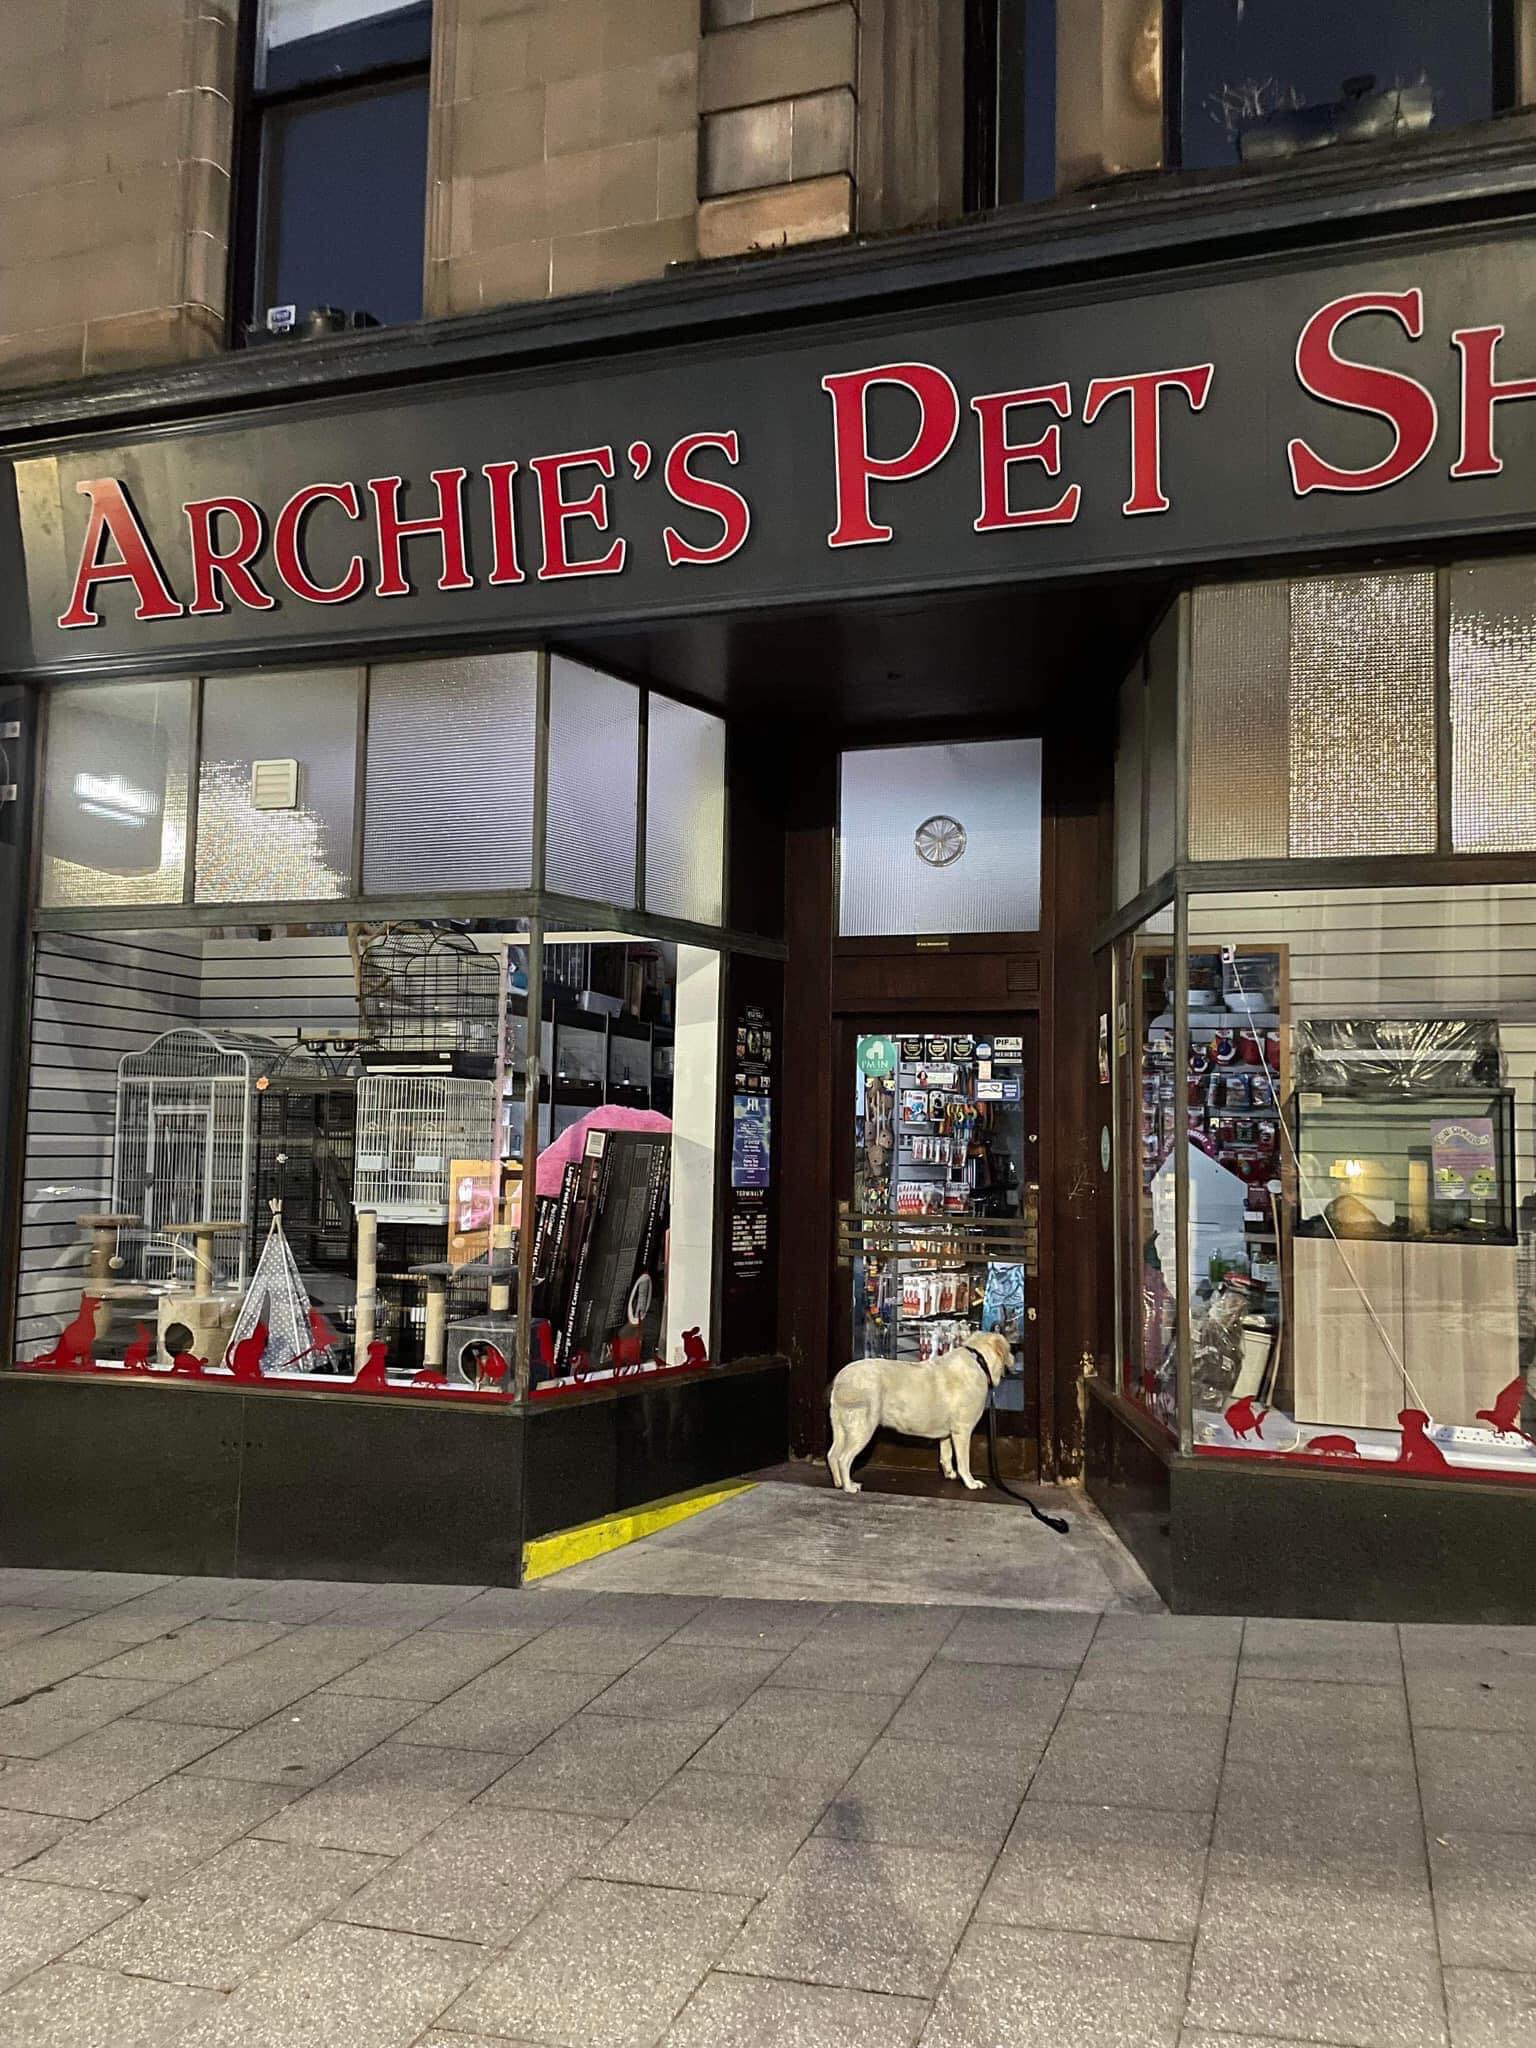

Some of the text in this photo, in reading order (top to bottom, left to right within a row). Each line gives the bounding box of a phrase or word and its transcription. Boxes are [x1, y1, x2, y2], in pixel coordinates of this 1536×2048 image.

[57, 430, 750, 628] ARCHIE'S
[821, 361, 1214, 549] PET
[878, 1060, 889, 1069] IN
[554, 1166, 574, 1244] Large Fold Flat Carrier
[569, 1281, 581, 1305] Carrier
[567, 1305, 577, 1320] Flat
[565, 1320, 574, 1337] Fold
